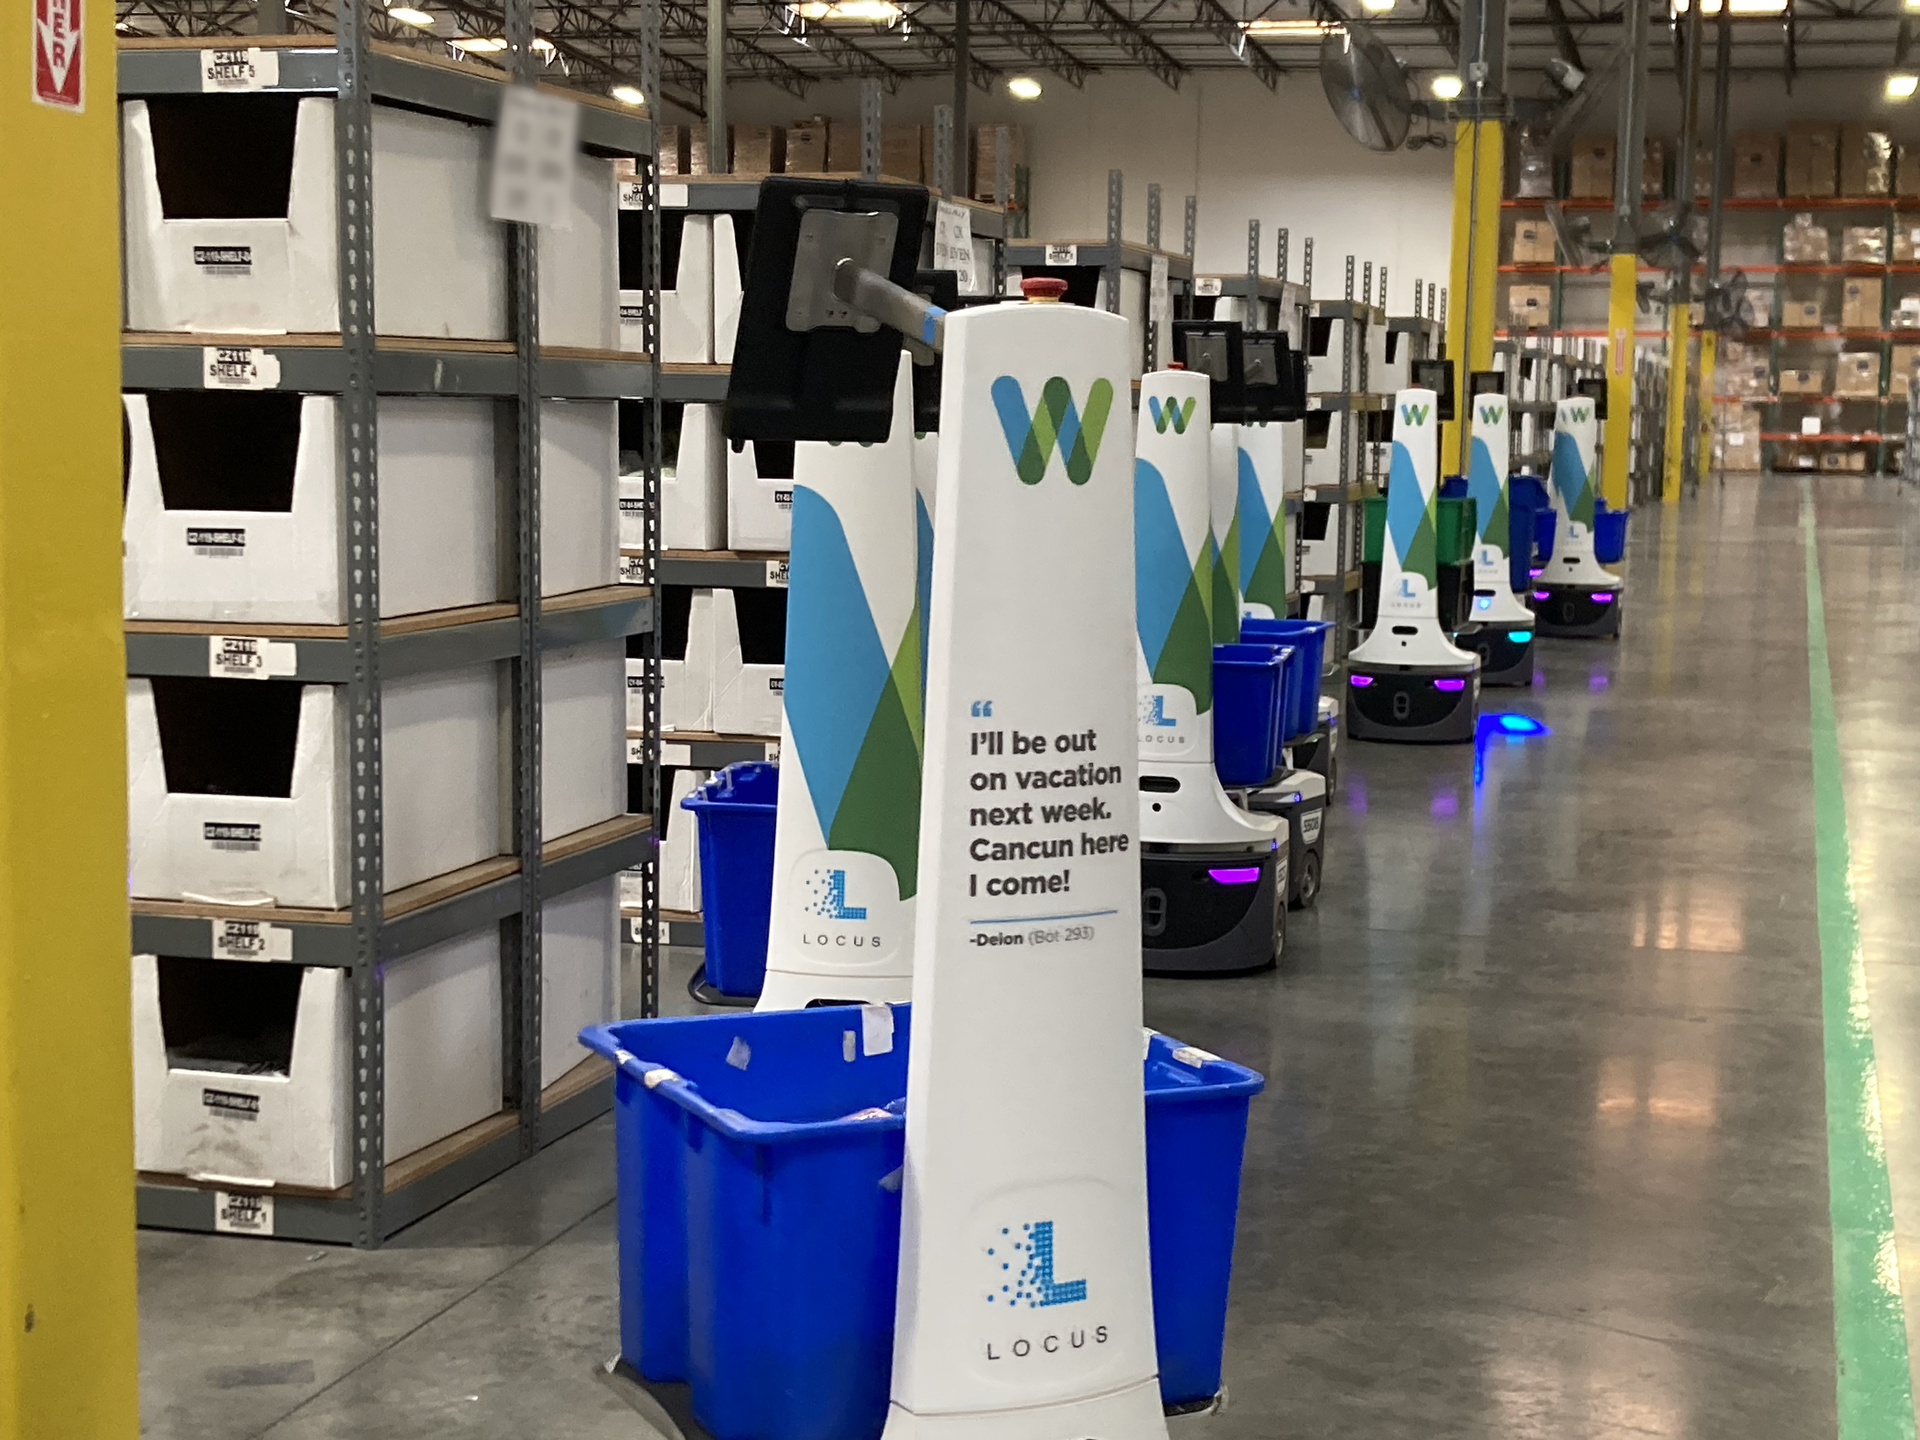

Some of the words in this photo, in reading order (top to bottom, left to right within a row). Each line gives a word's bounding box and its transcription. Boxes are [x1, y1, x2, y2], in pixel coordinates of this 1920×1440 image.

[207, 65, 245, 80] SHELF
[248, 64, 256, 78] 5
[209, 364, 247, 378] SHELF
[250, 365, 258, 379] 4
[990, 376, 1114, 485] W
[215, 653, 252, 667] SHELF
[256, 655, 263, 668] 3
[1012, 731, 1047, 755] be
[1054, 729, 1097, 753] out
[970, 772, 1007, 791] on
[1015, 762, 1122, 790] vacation
[970, 802, 1033, 827] next
[1041, 796, 1112, 824] week.
[969, 838, 1074, 862] Cancun
[1081, 832, 1129, 856] here
[970, 874, 977, 897] I
[986, 869, 1070, 896] come!
[258, 938, 265, 951] 2
[803, 933, 881, 948] LOCUS
[1028, 929, 1060, 946] (Bot
[1064, 926, 1095, 942] 293)
[986, 1325, 1109, 1361] LOCUS
